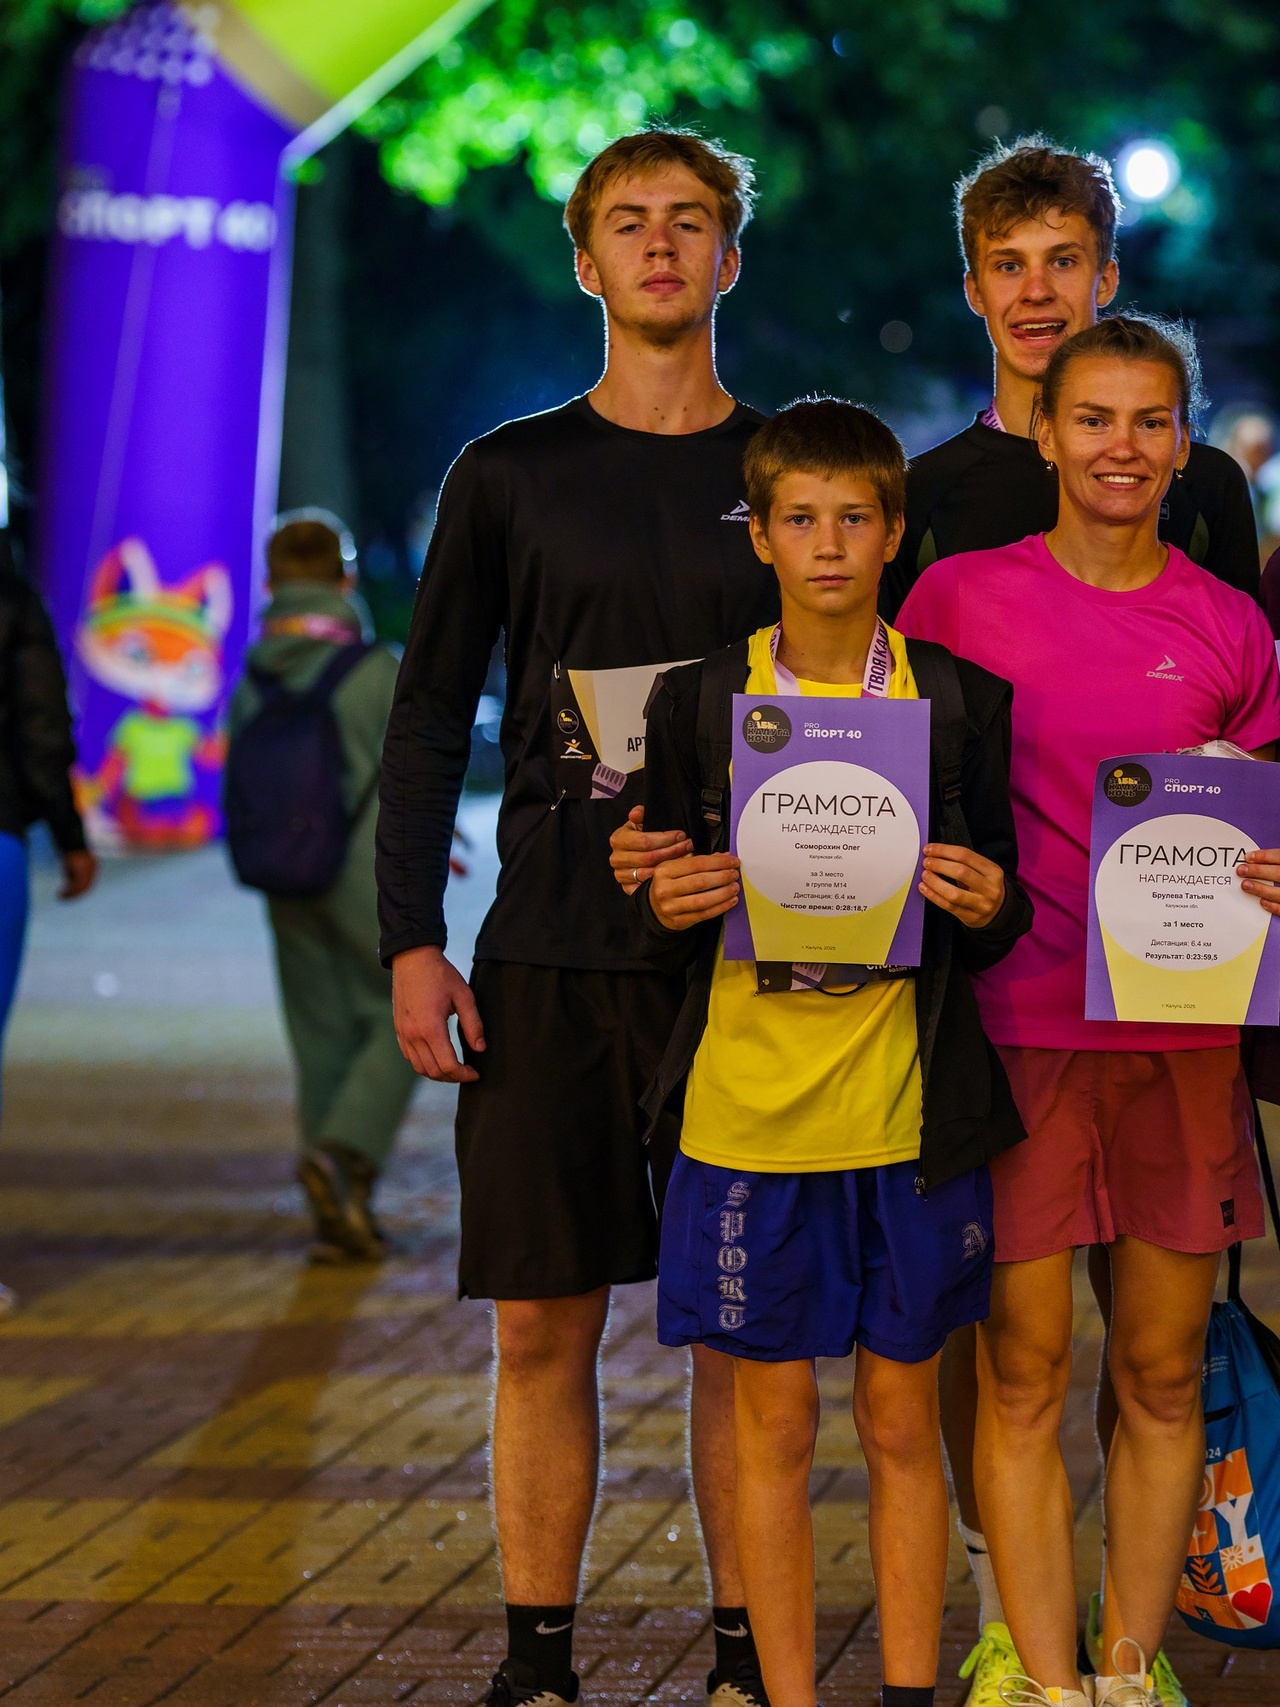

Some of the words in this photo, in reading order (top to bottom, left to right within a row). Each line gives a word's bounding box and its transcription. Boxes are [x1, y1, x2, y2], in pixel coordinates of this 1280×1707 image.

[867, 656, 887, 691] ТВОЯ
[1146, 671, 1184, 681] DEMIX
[804, 728, 845, 739] СПОРТ
[846, 730, 862, 739] 40
[627, 736, 646, 752] АР
[1164, 784, 1205, 794] СПОРТ
[1205, 785, 1221, 795] 40
[761, 792, 896, 817] ГРАМОТА
[781, 823, 876, 835] НАГРАЖДАЕТСЯ
[794, 842, 841, 851] Скоморохин
[842, 843, 861, 851] Олег
[1119, 844, 1248, 868] ГРАМОТА
[1139, 874, 1231, 885] НАГРАЖДАЕТСЯ
[793, 892, 833, 900] Дистанция:
[1152, 892, 1183, 900] Брулева
[780, 902, 807, 910] Чистое
[1151, 939, 1190, 947] Дистанция:
[1145, 952, 1185, 961] Результат:
[1186, 953, 1218, 961] 0:23:59,5
[716, 1180, 750, 1331] SPORT
